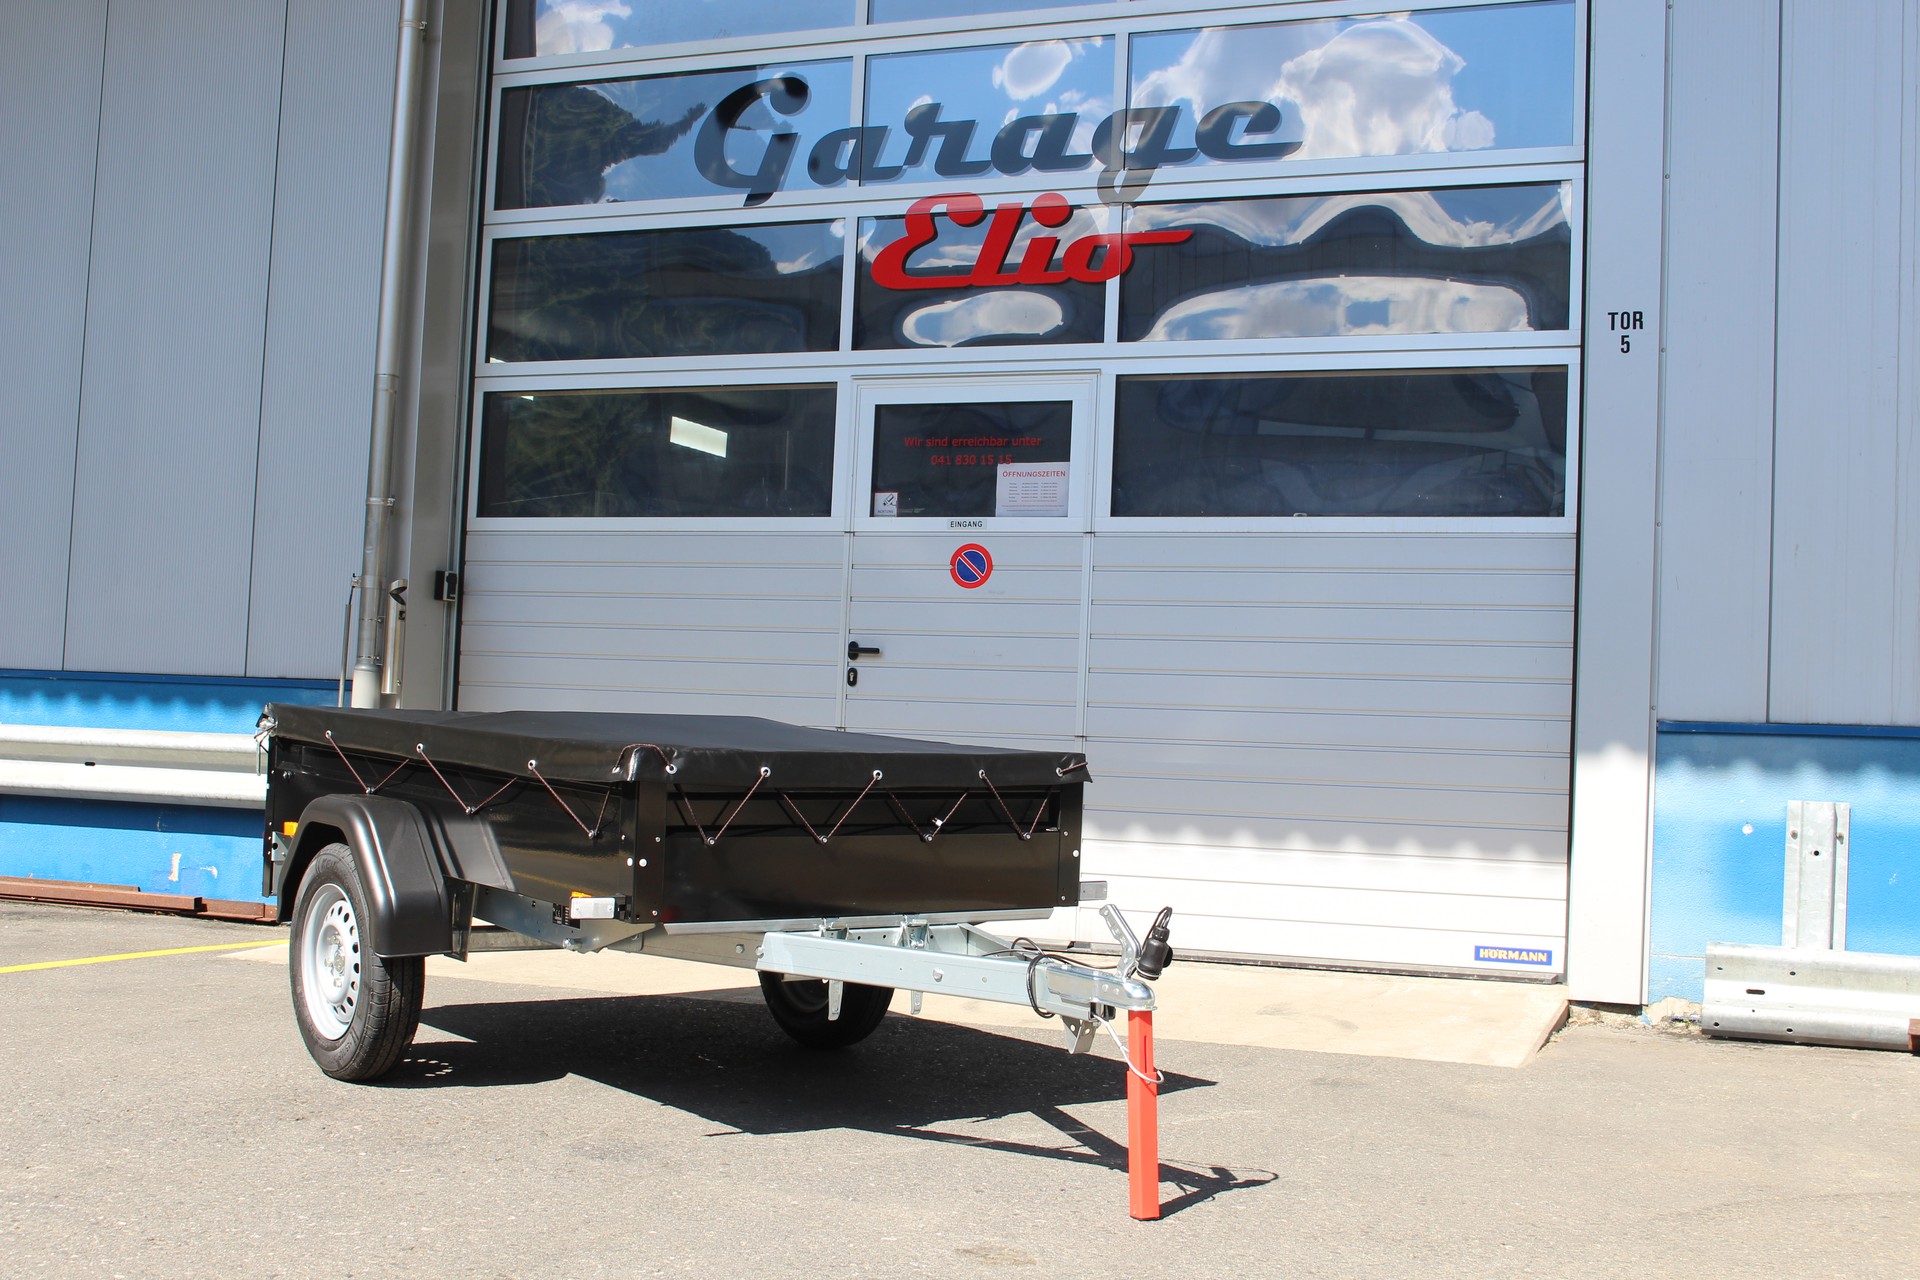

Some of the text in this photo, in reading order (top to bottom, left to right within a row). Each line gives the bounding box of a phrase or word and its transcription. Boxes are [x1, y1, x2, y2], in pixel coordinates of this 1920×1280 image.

[694, 76, 1303, 206] Garage
[870, 192, 1192, 290] Elio
[1607, 310, 1644, 331] TOR
[1620, 334, 1631, 354] 5
[904, 437, 1042, 447] Wir sind erreichbar unter
[931, 455, 1012, 465] 041 830 15 15
[1002, 470, 1066, 478] ÖFFNUNGSZEITEN
[1479, 948, 1548, 962] HÖRMANN
